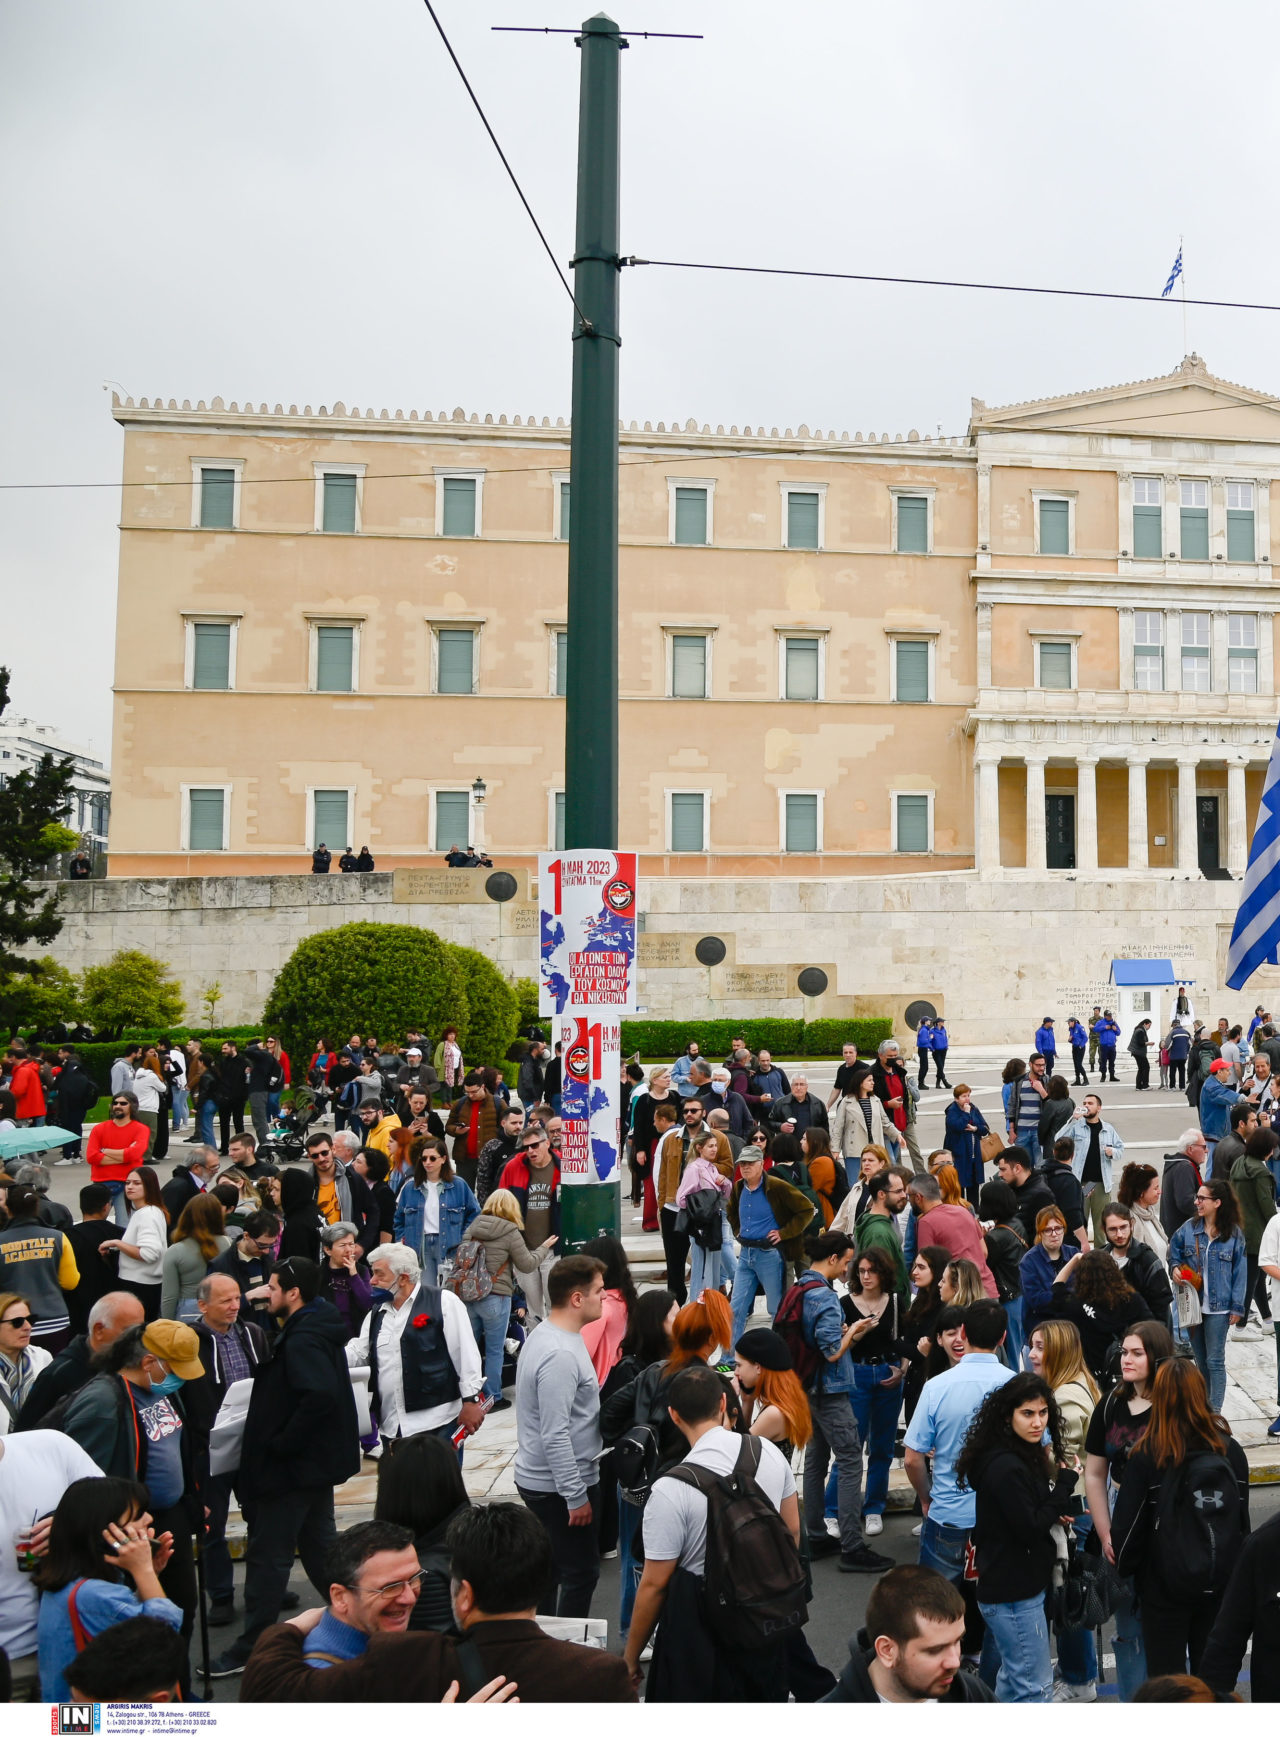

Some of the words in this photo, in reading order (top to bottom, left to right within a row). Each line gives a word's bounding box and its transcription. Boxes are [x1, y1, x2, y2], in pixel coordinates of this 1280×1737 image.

[548, 859, 562, 915] 1
[587, 860, 610, 874] 2023
[579, 952, 610, 965] ΑΓΩΝΕΣ
[613, 952, 625, 965] ΤΩΝ
[571, 965, 605, 978] ΕΡΓΑΤΩΝ
[577, 979, 592, 991] ΤΟΥ
[596, 979, 625, 990] ΚΟΣΜΟΥ
[575, 992, 584, 1004] ΘΑ
[588, 992, 625, 1004] ΝΙΚΗΣΟΥΝ
[589, 1023, 602, 1080] 1
[569, 1134, 588, 1145] ΟΛΟΥ
[5, 1247, 54, 1265] ACADEMY
